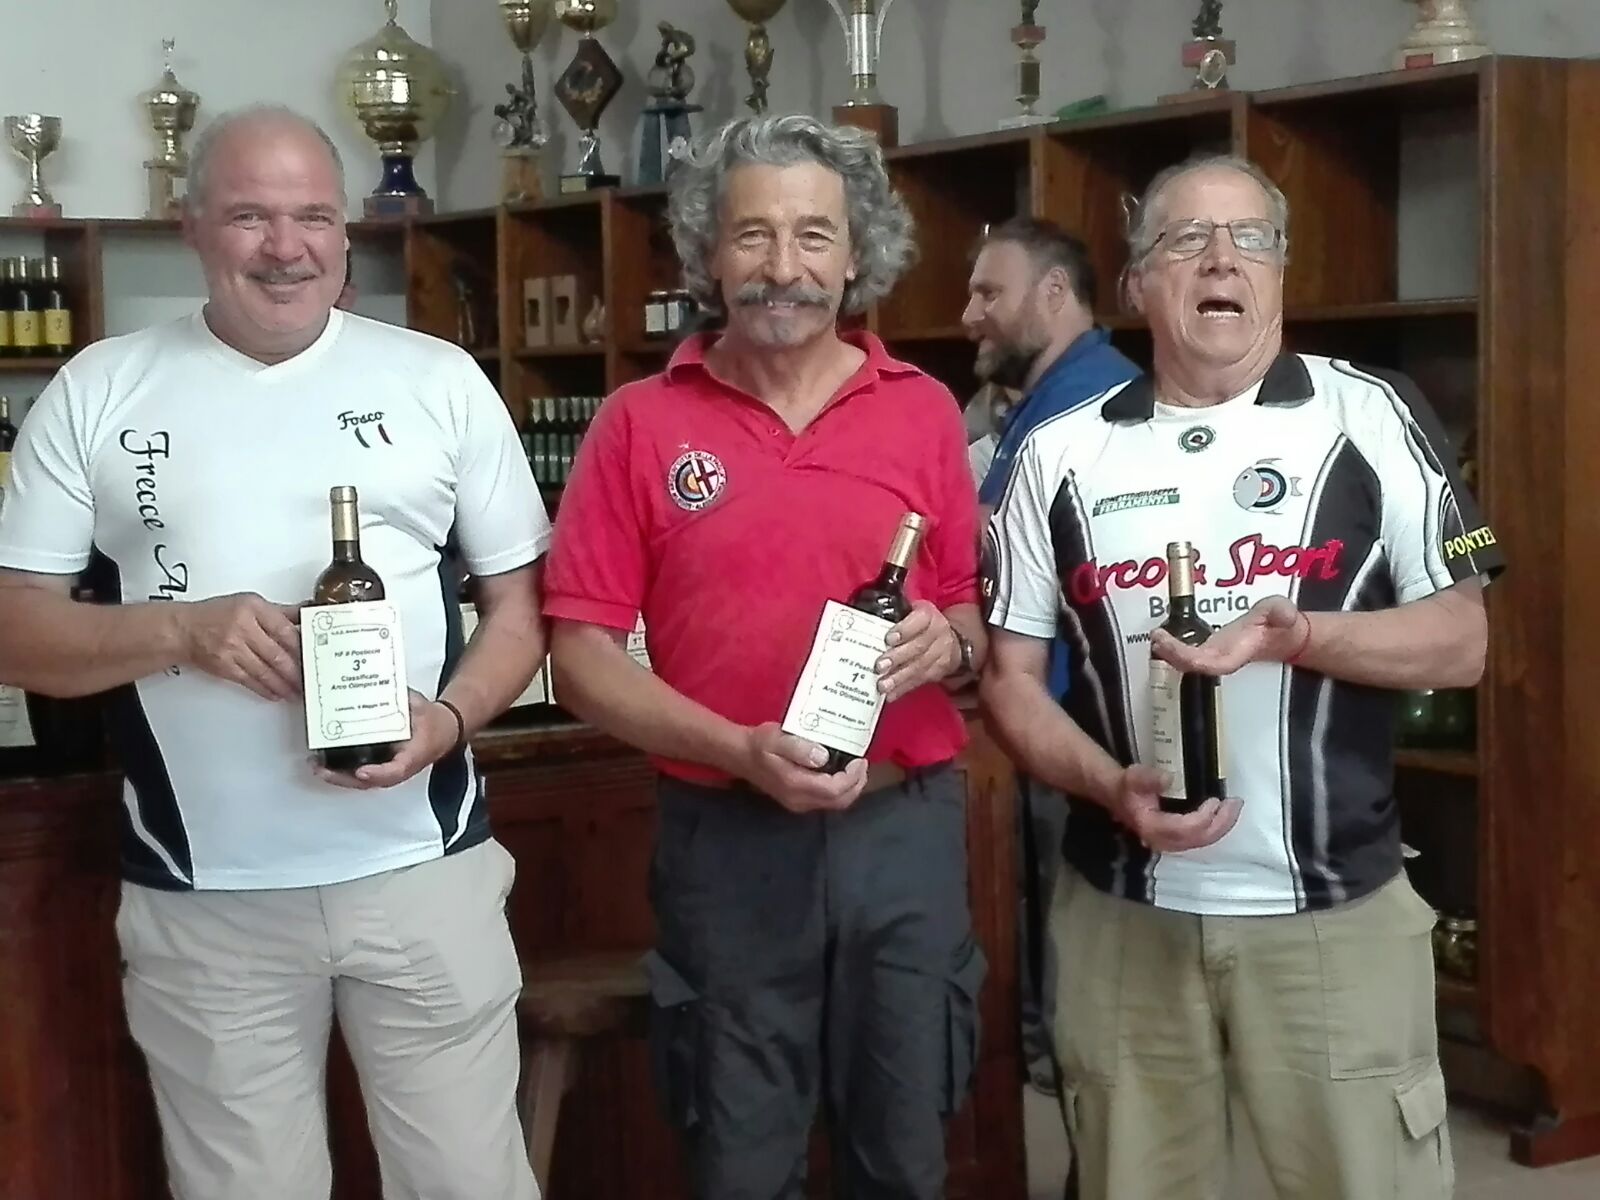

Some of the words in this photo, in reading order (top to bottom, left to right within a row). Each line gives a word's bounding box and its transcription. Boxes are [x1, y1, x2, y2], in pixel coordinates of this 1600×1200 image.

[337, 410, 385, 430] Fosco
[119, 429, 169, 531] Frecce
[1444, 526, 1497, 559] PONTE
[1215, 533, 1343, 587] Sport
[1149, 591, 1249, 618] Baria
[341, 673, 379, 683] Classificato
